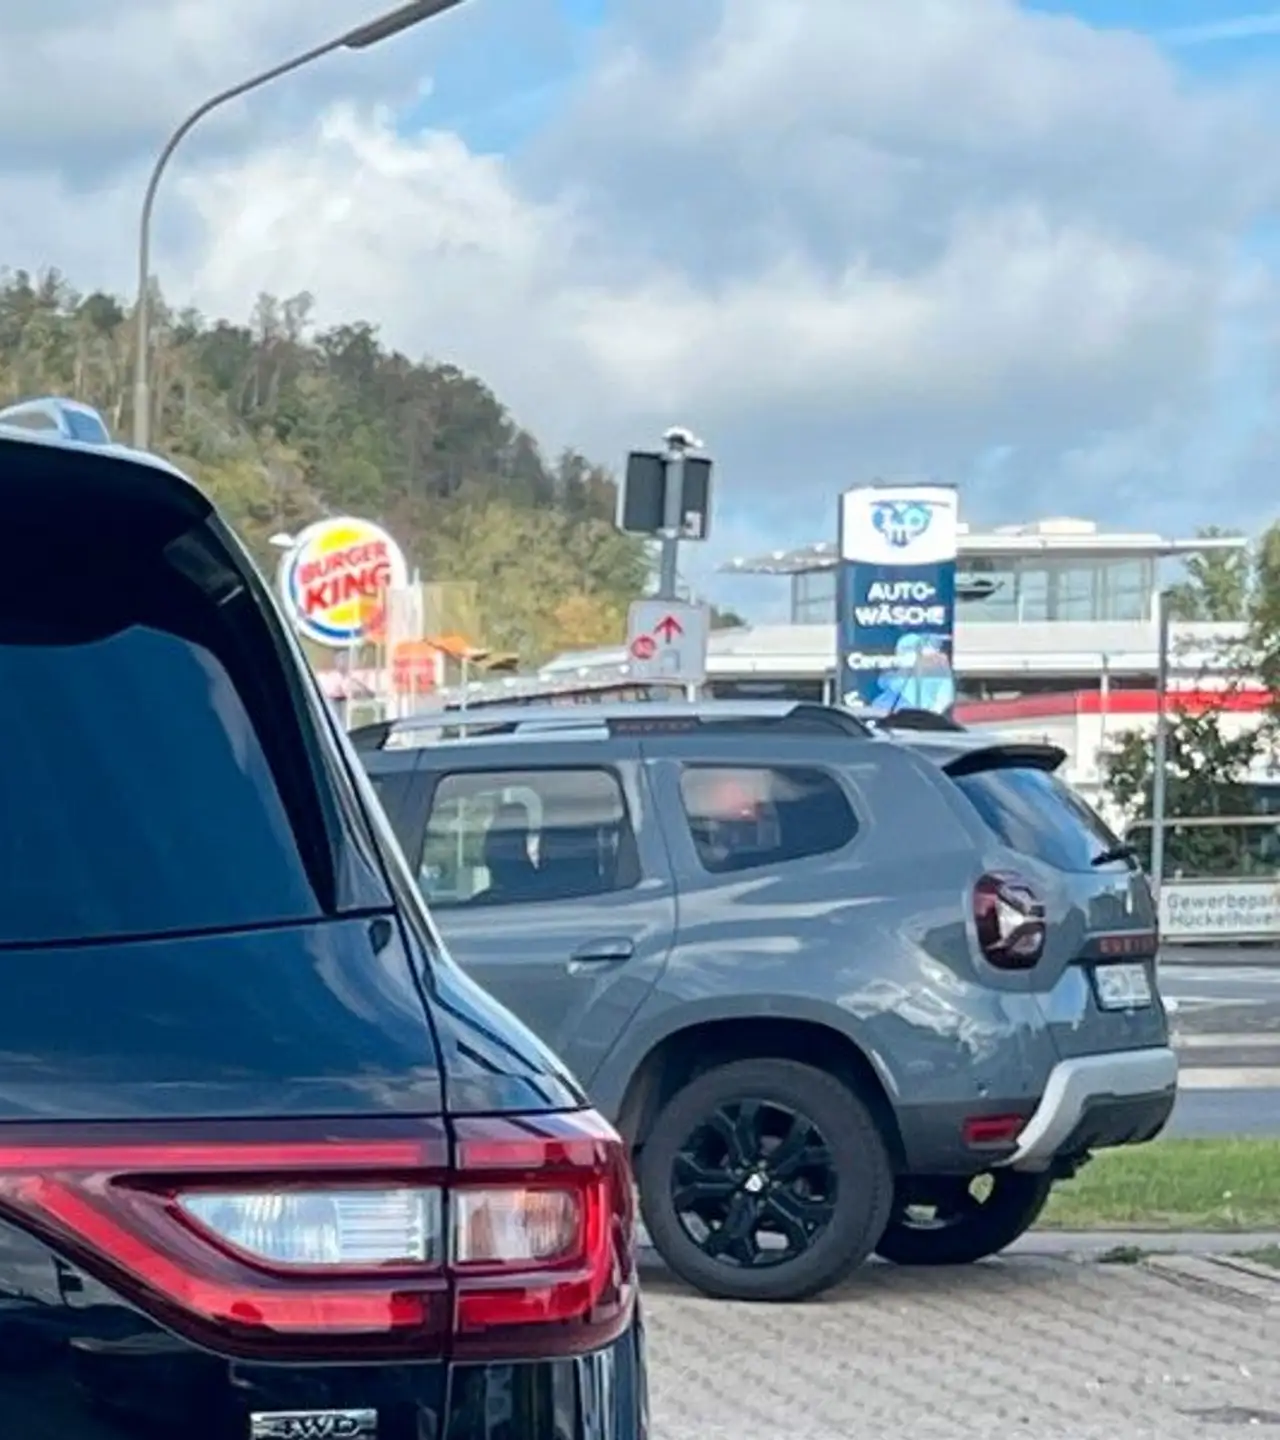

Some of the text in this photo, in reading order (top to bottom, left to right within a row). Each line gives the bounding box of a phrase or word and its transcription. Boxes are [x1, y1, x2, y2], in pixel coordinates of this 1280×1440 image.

[299, 540, 387, 585] BURGER
[306, 563, 391, 614] KING
[867, 581, 936, 602] AUTO-
